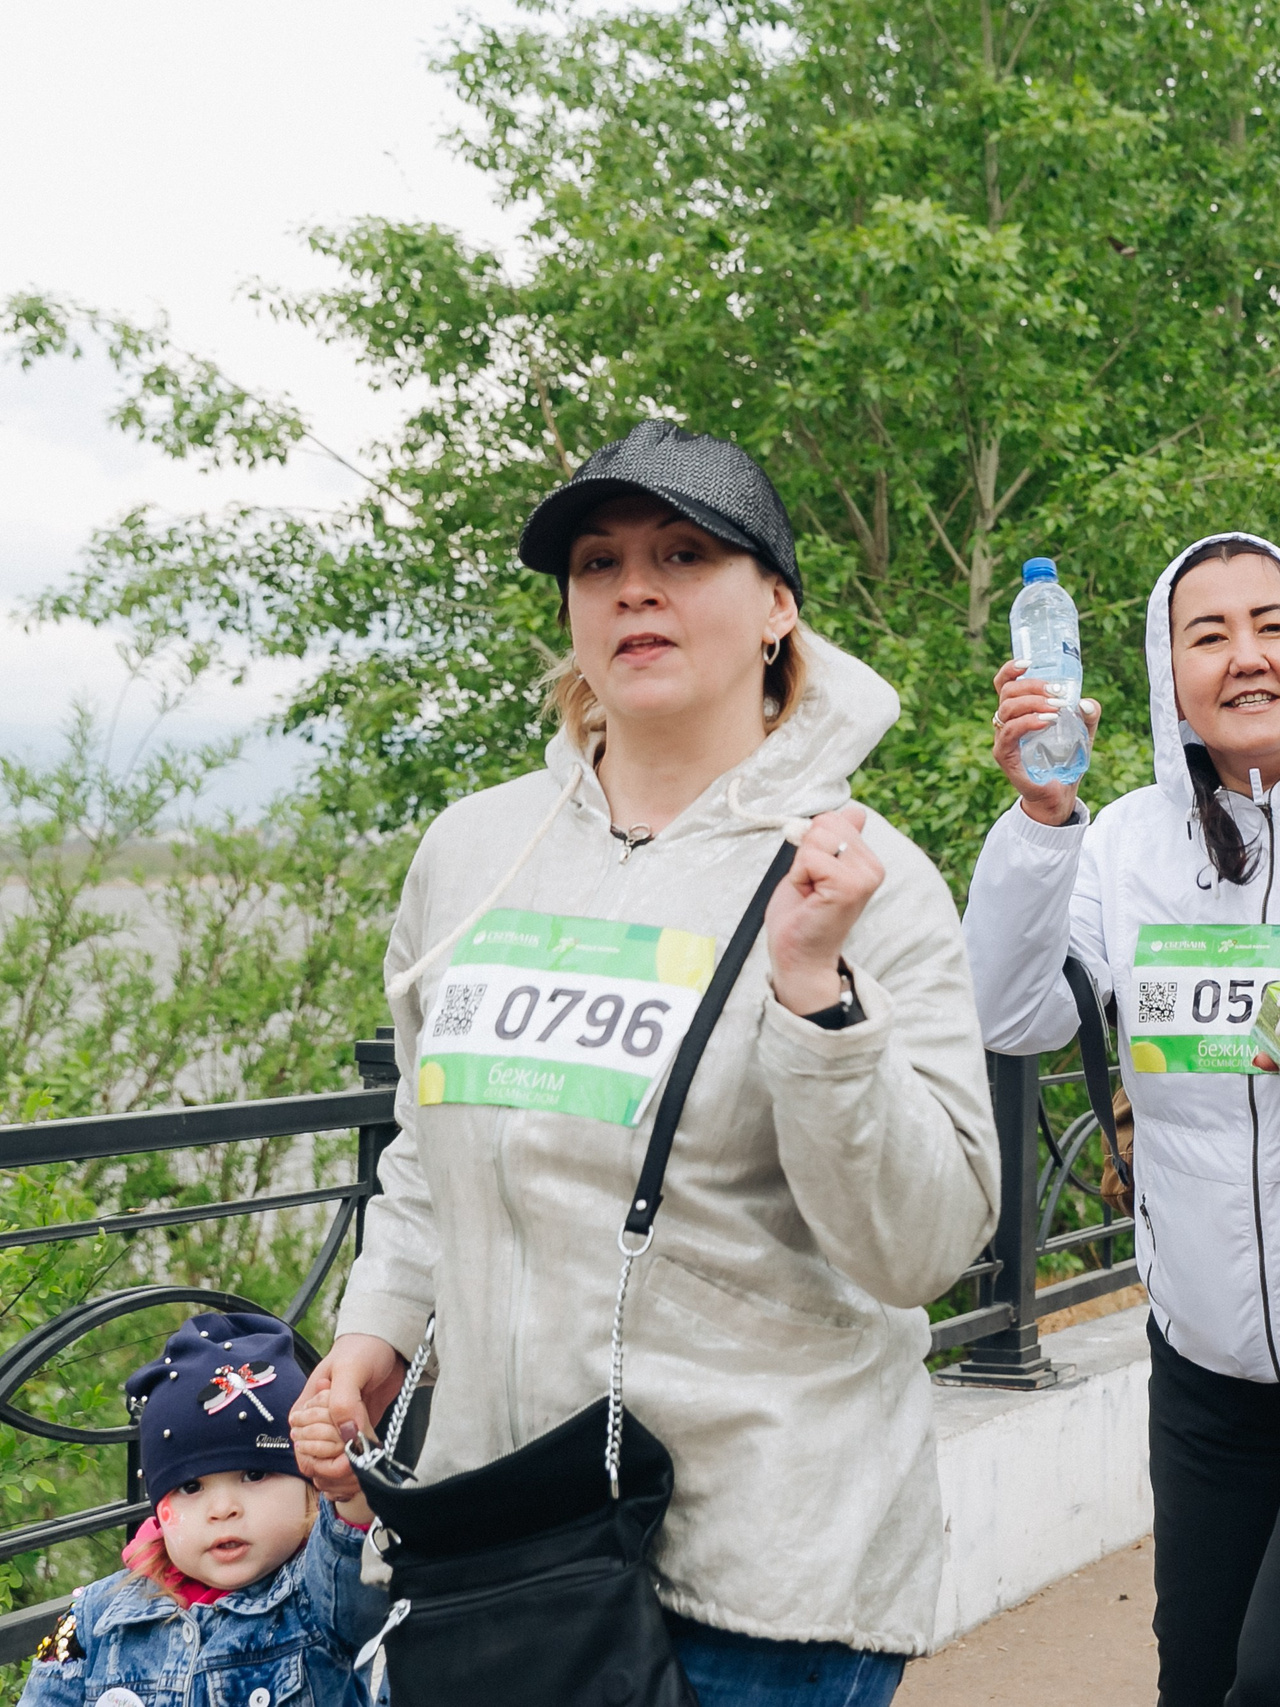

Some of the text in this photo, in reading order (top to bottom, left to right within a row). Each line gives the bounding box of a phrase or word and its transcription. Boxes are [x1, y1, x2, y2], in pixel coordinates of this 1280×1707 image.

[1192, 979, 1280, 1024] 05
[495, 985, 672, 1058] 0796
[1198, 1039, 1259, 1057] бежим
[488, 1061, 566, 1091] бежим
